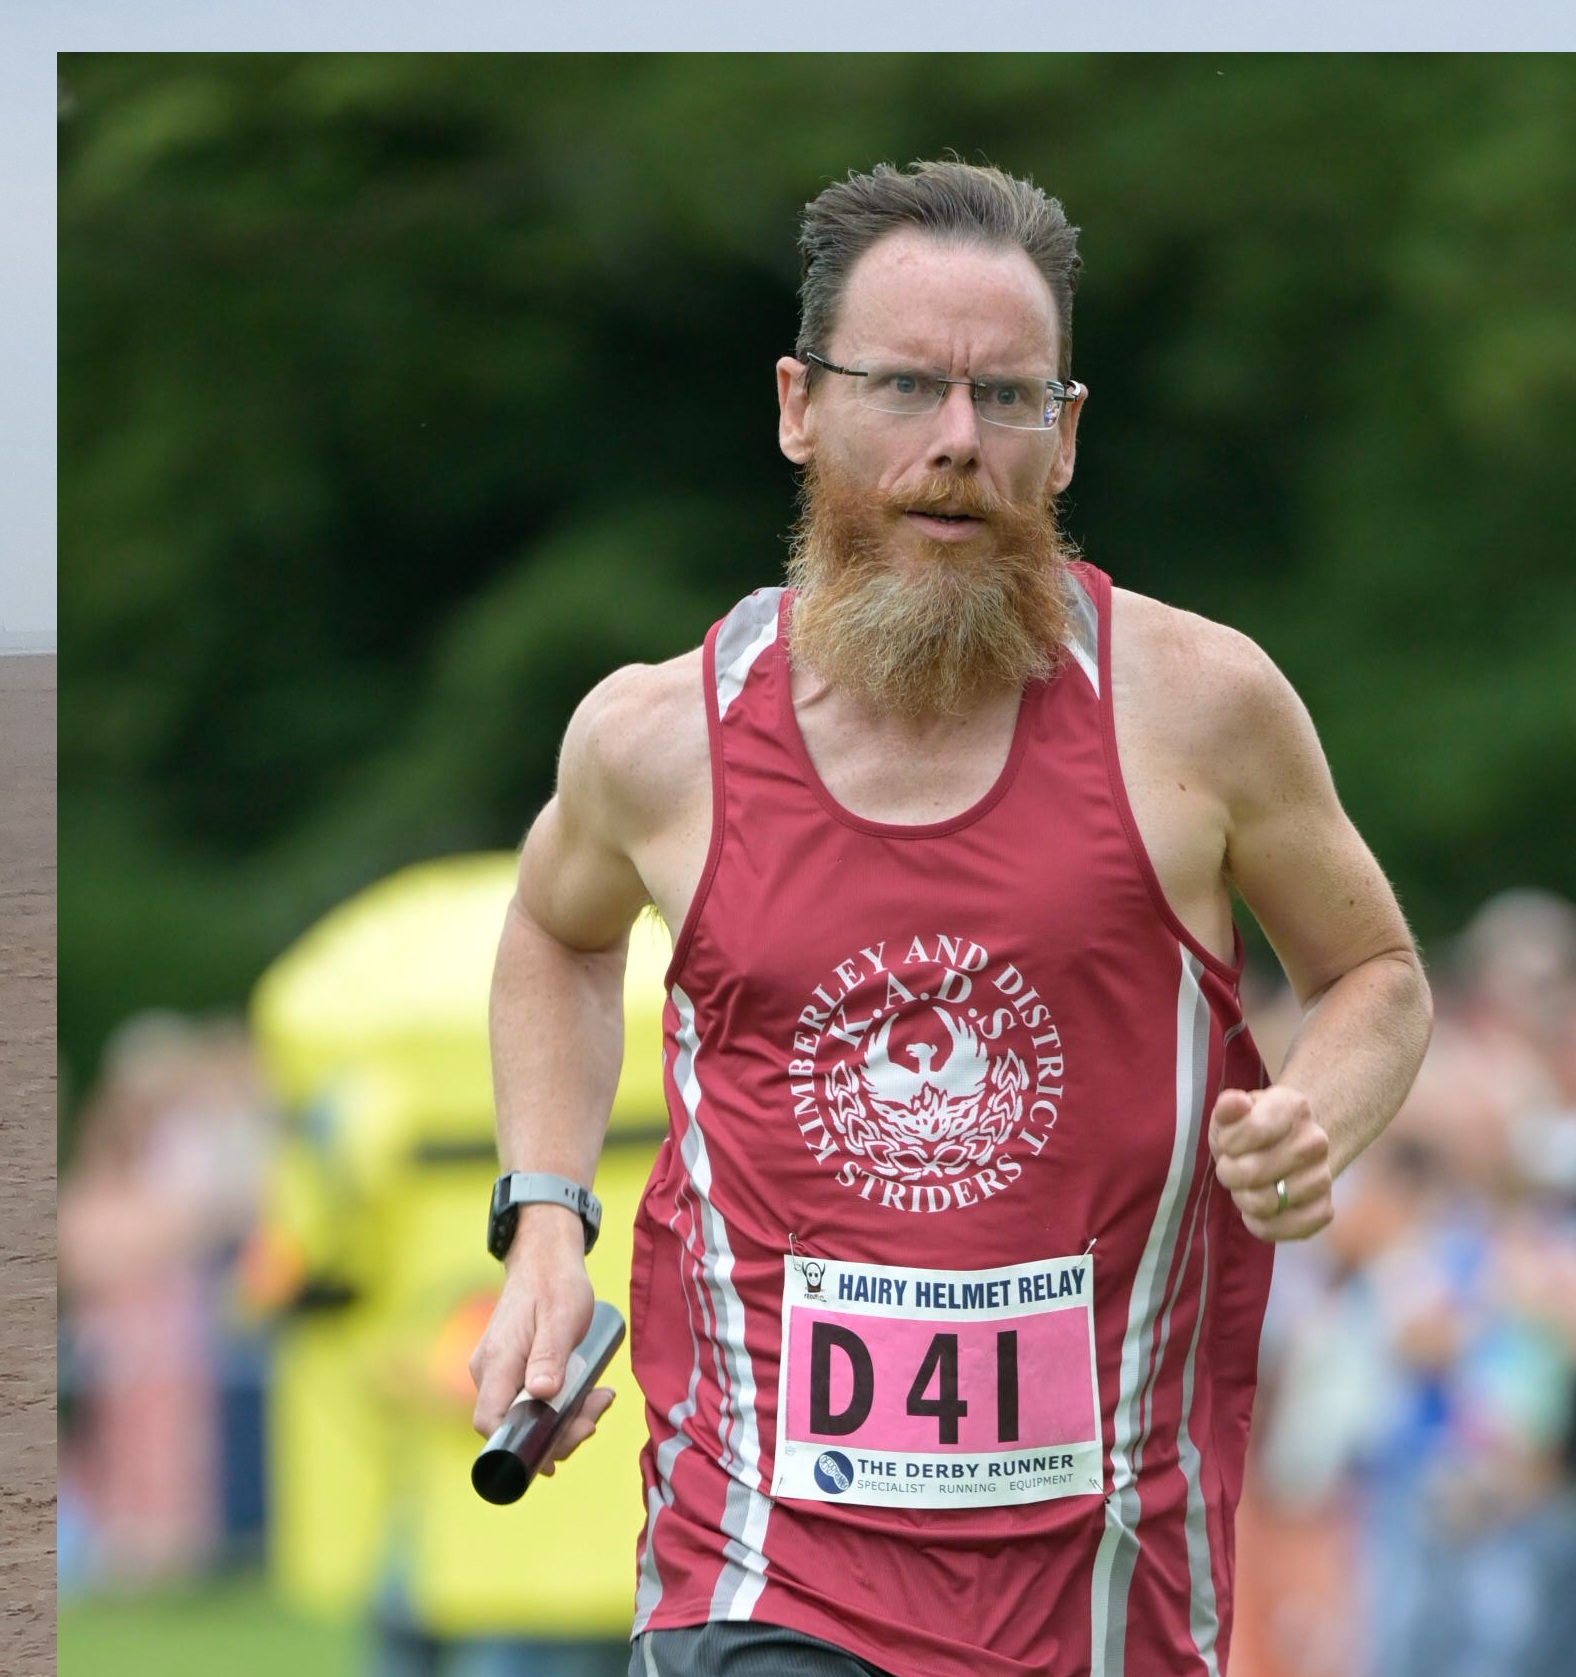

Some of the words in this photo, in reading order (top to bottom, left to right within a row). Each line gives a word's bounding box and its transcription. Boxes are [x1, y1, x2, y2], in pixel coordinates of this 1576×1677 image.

[788, 941, 888, 1166] KIMBERLEY
[903, 934, 989, 973] AND
[992, 962, 1064, 1157] DISTRICT
[834, 1152, 1023, 1214] STRIDERS
[838, 1273, 908, 1308] HAIRY
[915, 1279, 1011, 1310] HELMET
[1017, 1267, 1087, 1305] RELAY
[857, 1458, 897, 1477] THE
[905, 1462, 980, 1479] DERBY
[987, 1453, 1075, 1477] RUNNER
[857, 1479, 926, 1495] SPECIALIST
[938, 1481, 997, 1494] RUNNING
[1009, 1473, 1075, 1492] EQUIPMENT
